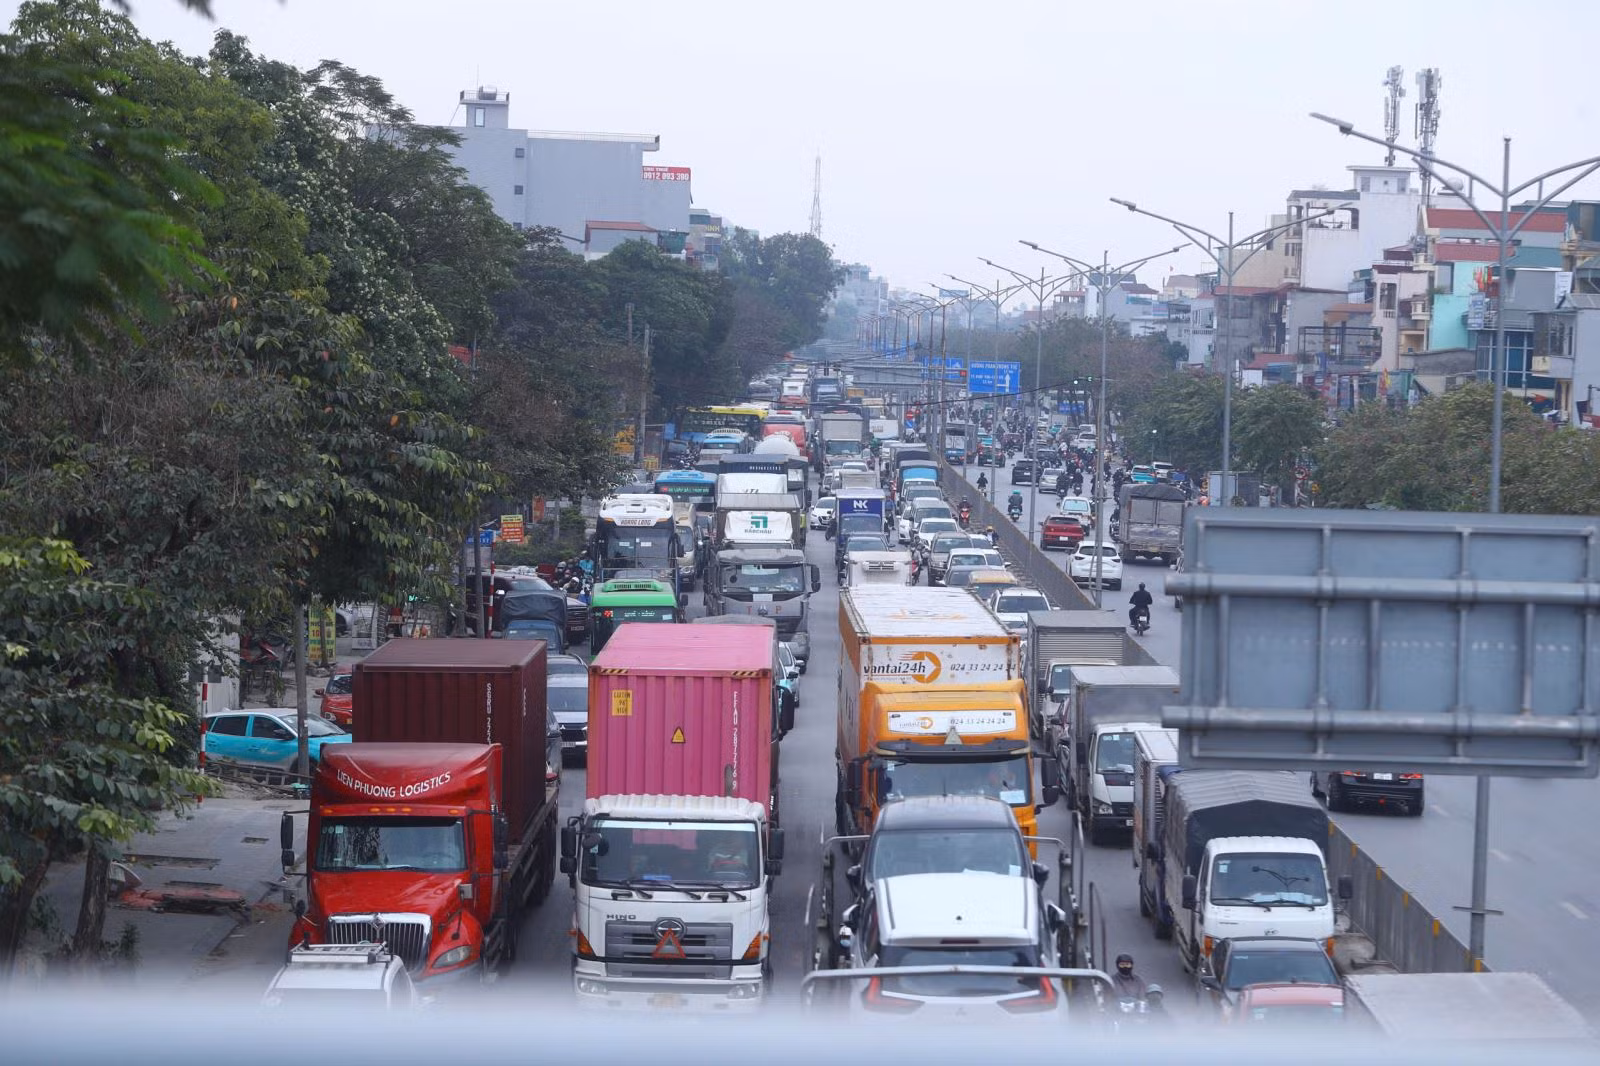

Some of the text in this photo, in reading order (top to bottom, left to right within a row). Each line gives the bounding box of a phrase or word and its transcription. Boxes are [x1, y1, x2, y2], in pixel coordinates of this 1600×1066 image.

[853, 500, 868, 509] NK
[863, 660, 926, 674] vantai24h
[950, 663, 965, 672] 024
[968, 663, 978, 672] 33
[980, 663, 991, 672] 24
[992, 663, 1003, 672] 24
[354, 780, 396, 798] PHUONG
[400, 771, 451, 797] LOGISTICS
